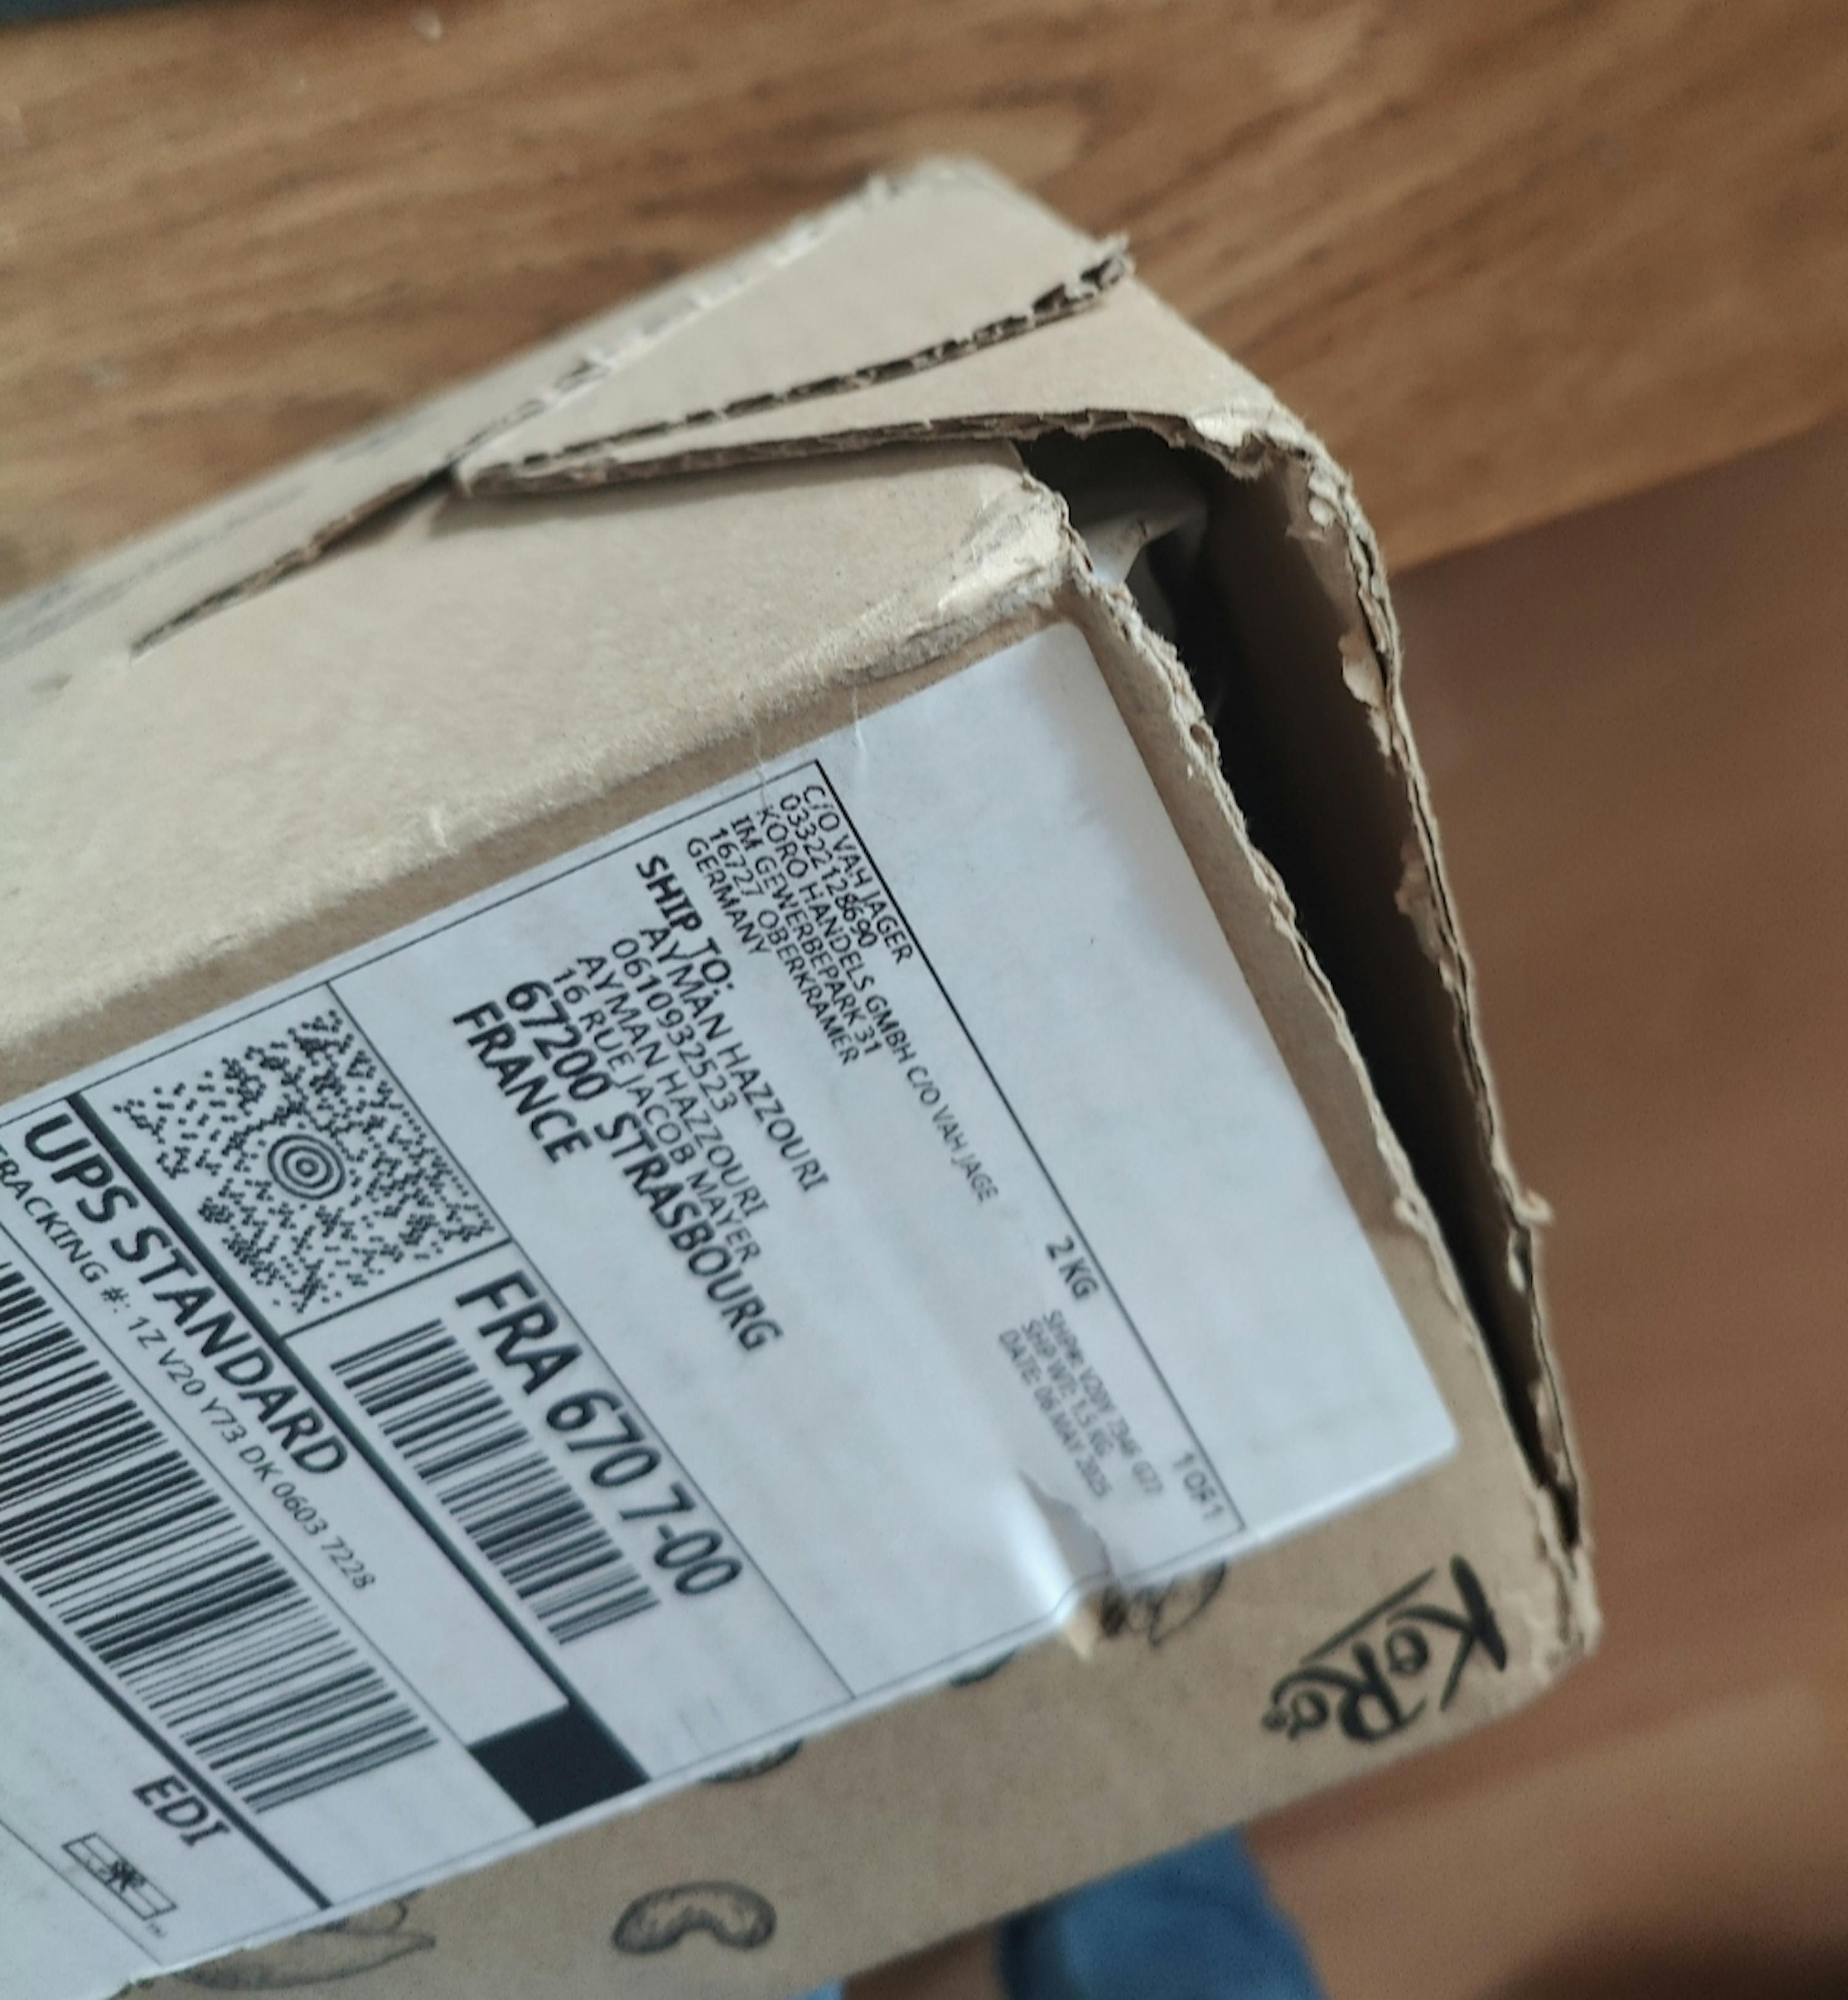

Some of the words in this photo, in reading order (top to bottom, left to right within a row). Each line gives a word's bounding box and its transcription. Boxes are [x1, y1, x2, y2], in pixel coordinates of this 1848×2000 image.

[779, 792, 878, 948] 03322128690
[801, 784, 841, 833] C/O
[832, 833, 873, 888] VAH
[634, 854, 703, 932] SHIP
[687, 936, 734, 996] TO:
[686, 837, 769, 954] GERMANY
[708, 826, 764, 896] 16727
[756, 909, 859, 1065] OBERKRAMER
[729, 813, 764, 852] IM
[754, 855, 866, 1026] GEWERBEPARK
[853, 1025, 883, 1055] 31
[850, 890, 914, 964] JAGER
[452, 1000, 593, 1164] FRANCE
[610, 937, 738, 1113] 0610932523
[638, 922, 732, 1042] AYMAN
[716, 1041, 829, 1192] HAZZOURI
[756, 805, 809, 879] KORO
[798, 880, 875, 992] HANDELS
[864, 994, 916, 1063] GMBH
[905, 1065, 941, 1106] C/O
[931, 1104, 966, 1152] VAH
[950, 1153, 999, 1203] JAGE
[552, 967, 590, 1005] 16
[578, 1008, 635, 1071] RUE
[610, 1073, 697, 1166] JACOB
[685, 1168, 761, 1264] MAYER
[575, 955, 670, 1069] AYMAN
[655, 1069, 768, 1218] HAZZOURI
[505, 980, 618, 1102] 67200
[593, 1111, 782, 1352] STRASBOURG
[23, 1113, 139, 1224] UPS
[108, 1225, 348, 1474] STANDARD
[1045, 1235, 1075, 1261] 2
[1058, 1257, 1098, 1300] KG
[0, 1144, 109, 1283] RACKING
[100, 1287, 130, 1313] #:
[127, 1316, 168, 1349] 1Z
[156, 1347, 206, 1397] V20
[200, 1396, 248, 1444] Y73
[237, 1444, 280, 1483] DK
[270, 1481, 328, 1537] 0603
[320, 1535, 376, 1590] 7228
[454, 1270, 583, 1396] FRA
[545, 1389, 662, 1489] 670
[618, 1482, 743, 1597] 7-00
[1048, 1411, 1084, 1452] MAY
[1173, 1451, 1198, 1470] 1
[1183, 1470, 1217, 1504] OF
[1202, 1502, 1226, 1520] 1
[132, 1775, 230, 1847] EDI
